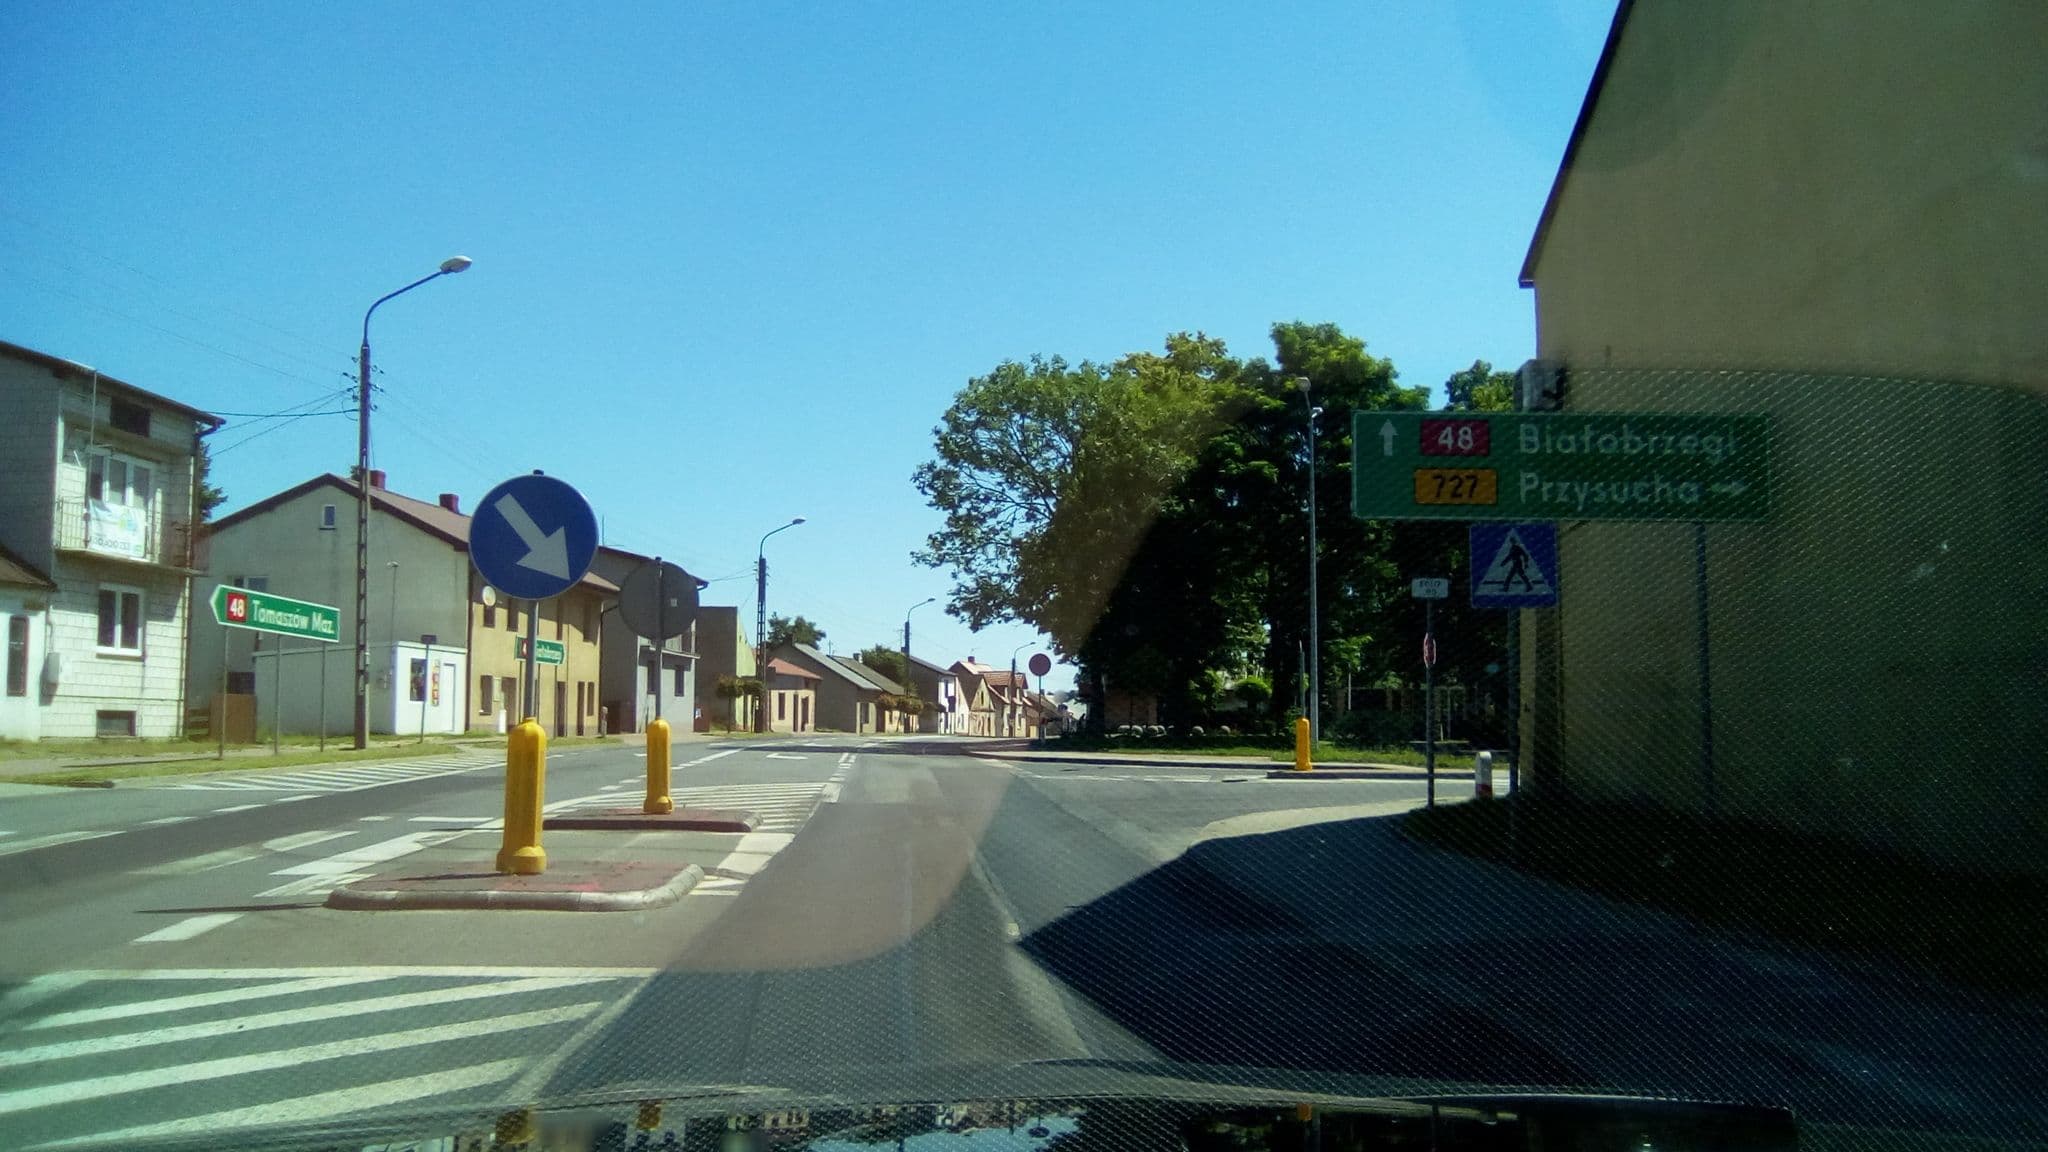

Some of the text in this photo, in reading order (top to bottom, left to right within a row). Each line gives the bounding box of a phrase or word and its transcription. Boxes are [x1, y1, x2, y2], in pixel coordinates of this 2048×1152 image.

[1438, 426, 1474, 451] 48
[1432, 471, 1700, 511] 727 Przysucha
[229, 598, 245, 618] 48
[252, 599, 310, 630] Tomaszów
